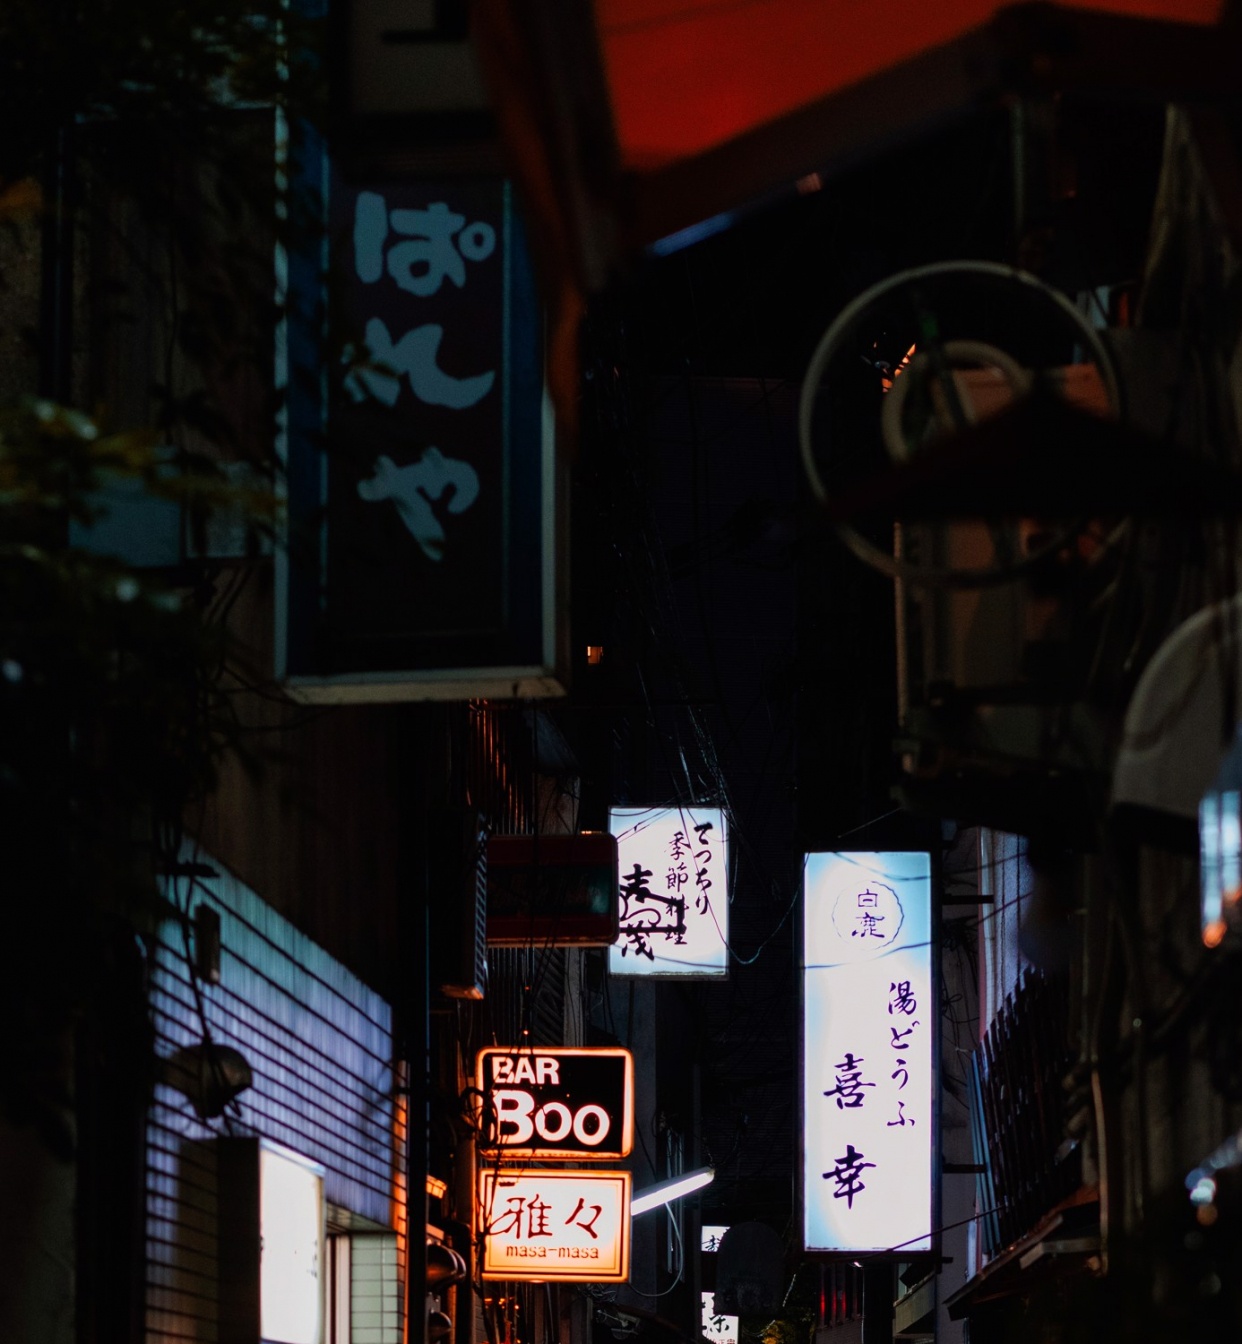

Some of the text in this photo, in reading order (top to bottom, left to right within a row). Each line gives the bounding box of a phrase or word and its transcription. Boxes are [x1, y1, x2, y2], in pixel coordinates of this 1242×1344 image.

[852, 888, 885, 938] 白鹿
[492, 1056, 560, 1085] BAR
[887, 980, 920, 1127] 湯どうふ
[822, 1053, 877, 1210] 喜幸
[503, 1193, 603, 1240] 雅々
[506, 1245, 600, 1259] masa-masa
